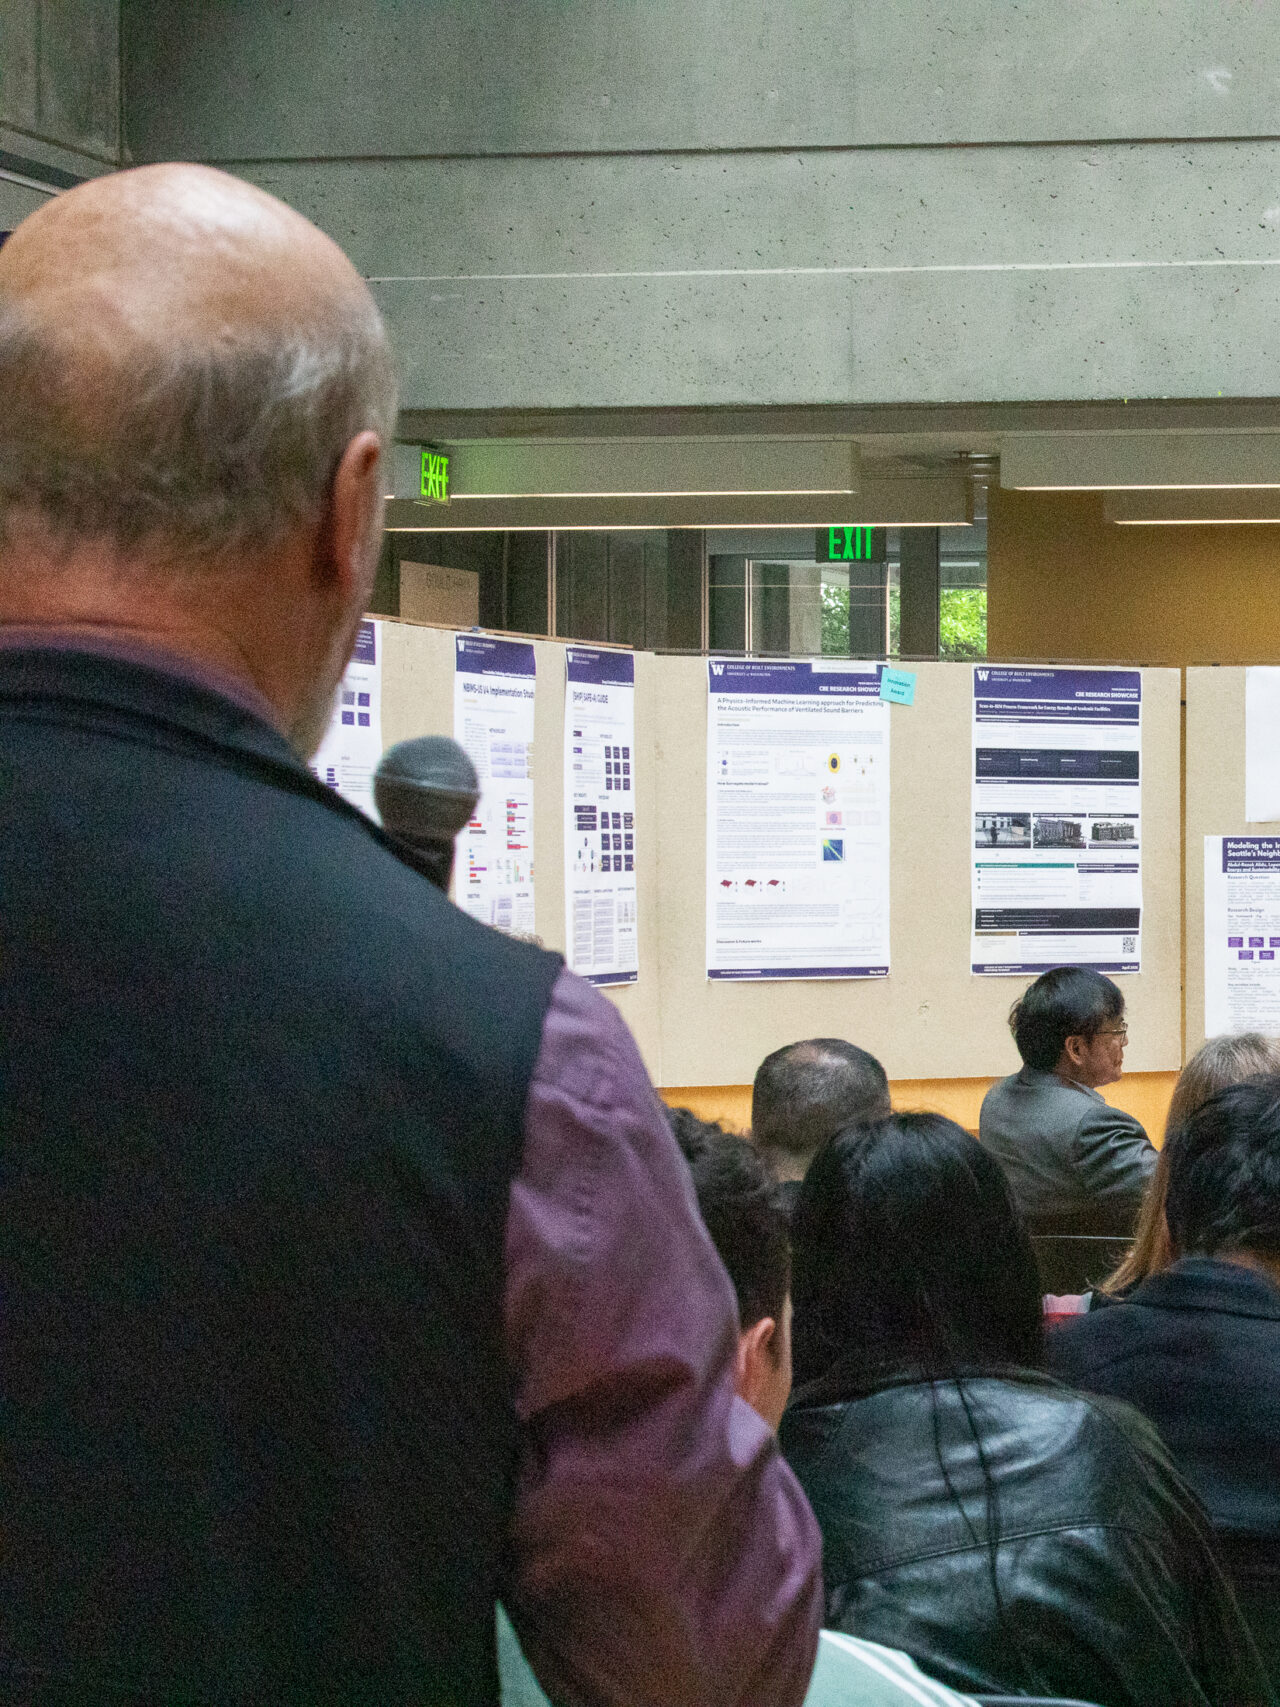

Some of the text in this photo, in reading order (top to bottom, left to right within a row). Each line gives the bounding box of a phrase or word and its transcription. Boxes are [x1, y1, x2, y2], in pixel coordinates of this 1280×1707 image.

[421, 452, 448, 500] EXIT
[829, 527, 875, 559] EXIT
[712, 664, 724, 675] W
[977, 671, 989, 681] W
[1227, 842, 1259, 850] Modeling
